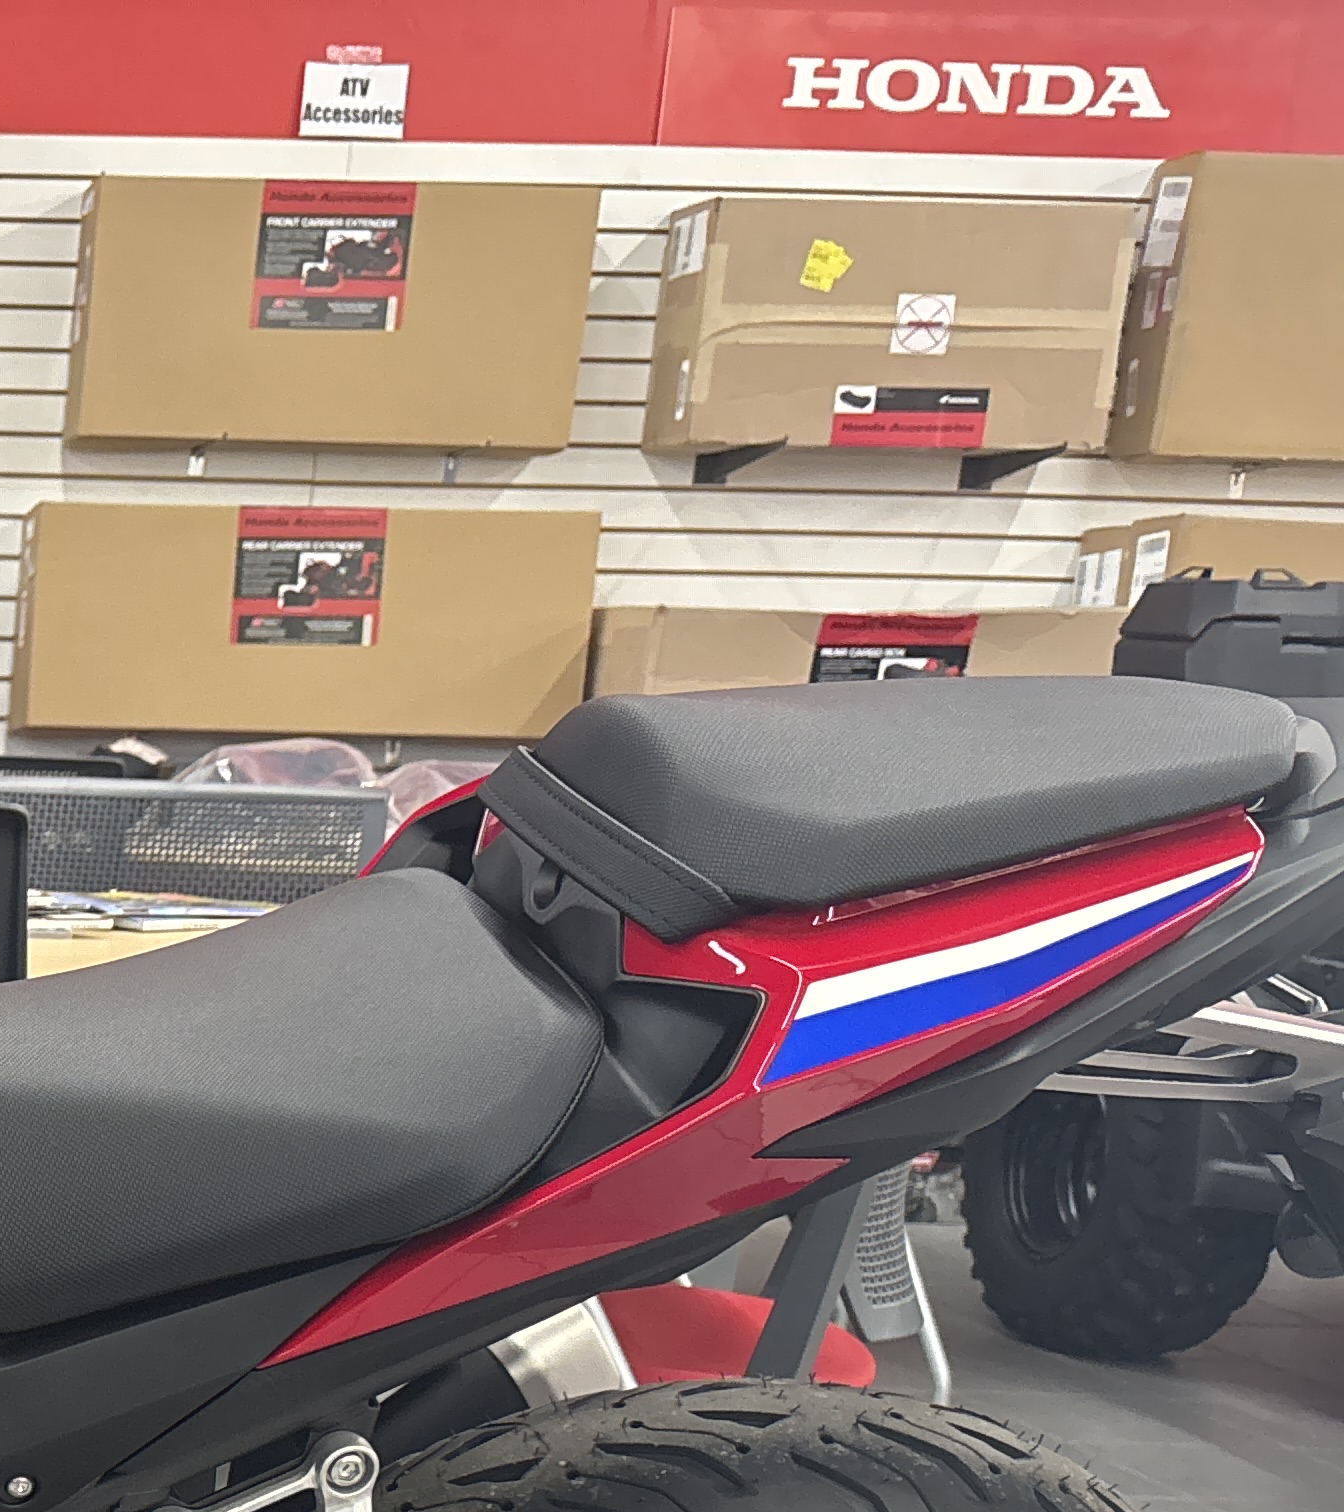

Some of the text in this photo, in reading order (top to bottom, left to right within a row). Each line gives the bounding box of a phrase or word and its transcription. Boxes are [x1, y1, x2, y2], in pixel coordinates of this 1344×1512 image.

[339, 77, 370, 97] ATV
[782, 56, 1169, 120] HONDA
[303, 103, 404, 125] Accessories
